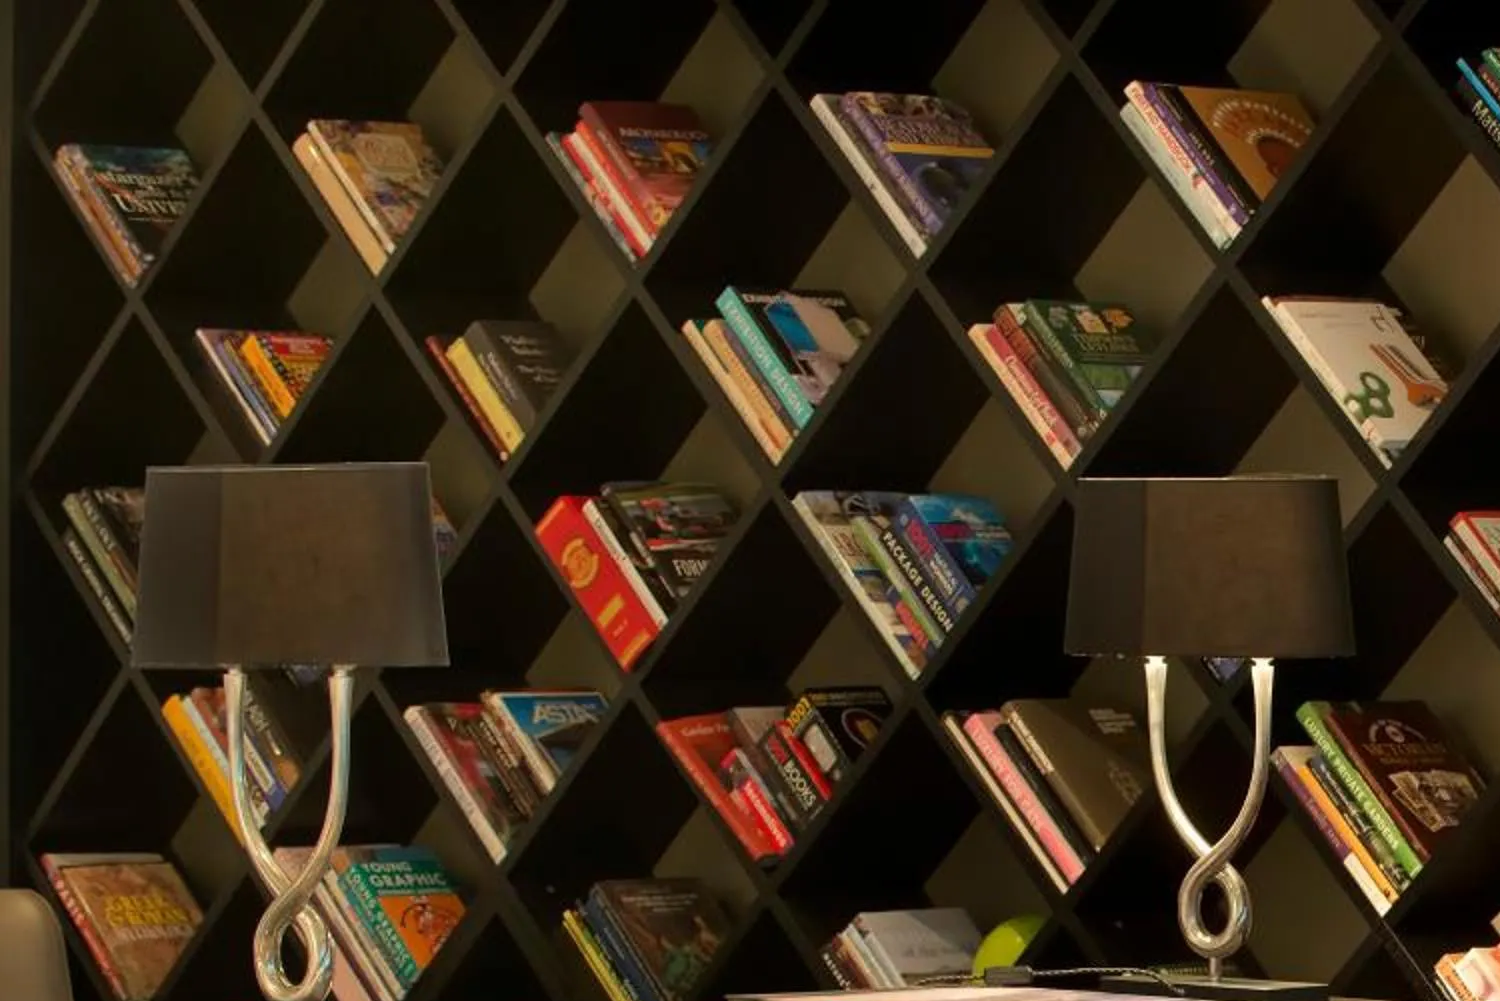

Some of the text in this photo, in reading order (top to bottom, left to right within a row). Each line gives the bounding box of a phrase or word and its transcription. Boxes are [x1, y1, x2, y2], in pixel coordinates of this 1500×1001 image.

[880, 530, 956, 633] PACKAGE DESIGN
[781, 758, 818, 808] BOOKS
[370, 873, 448, 888] GRAPHIC
